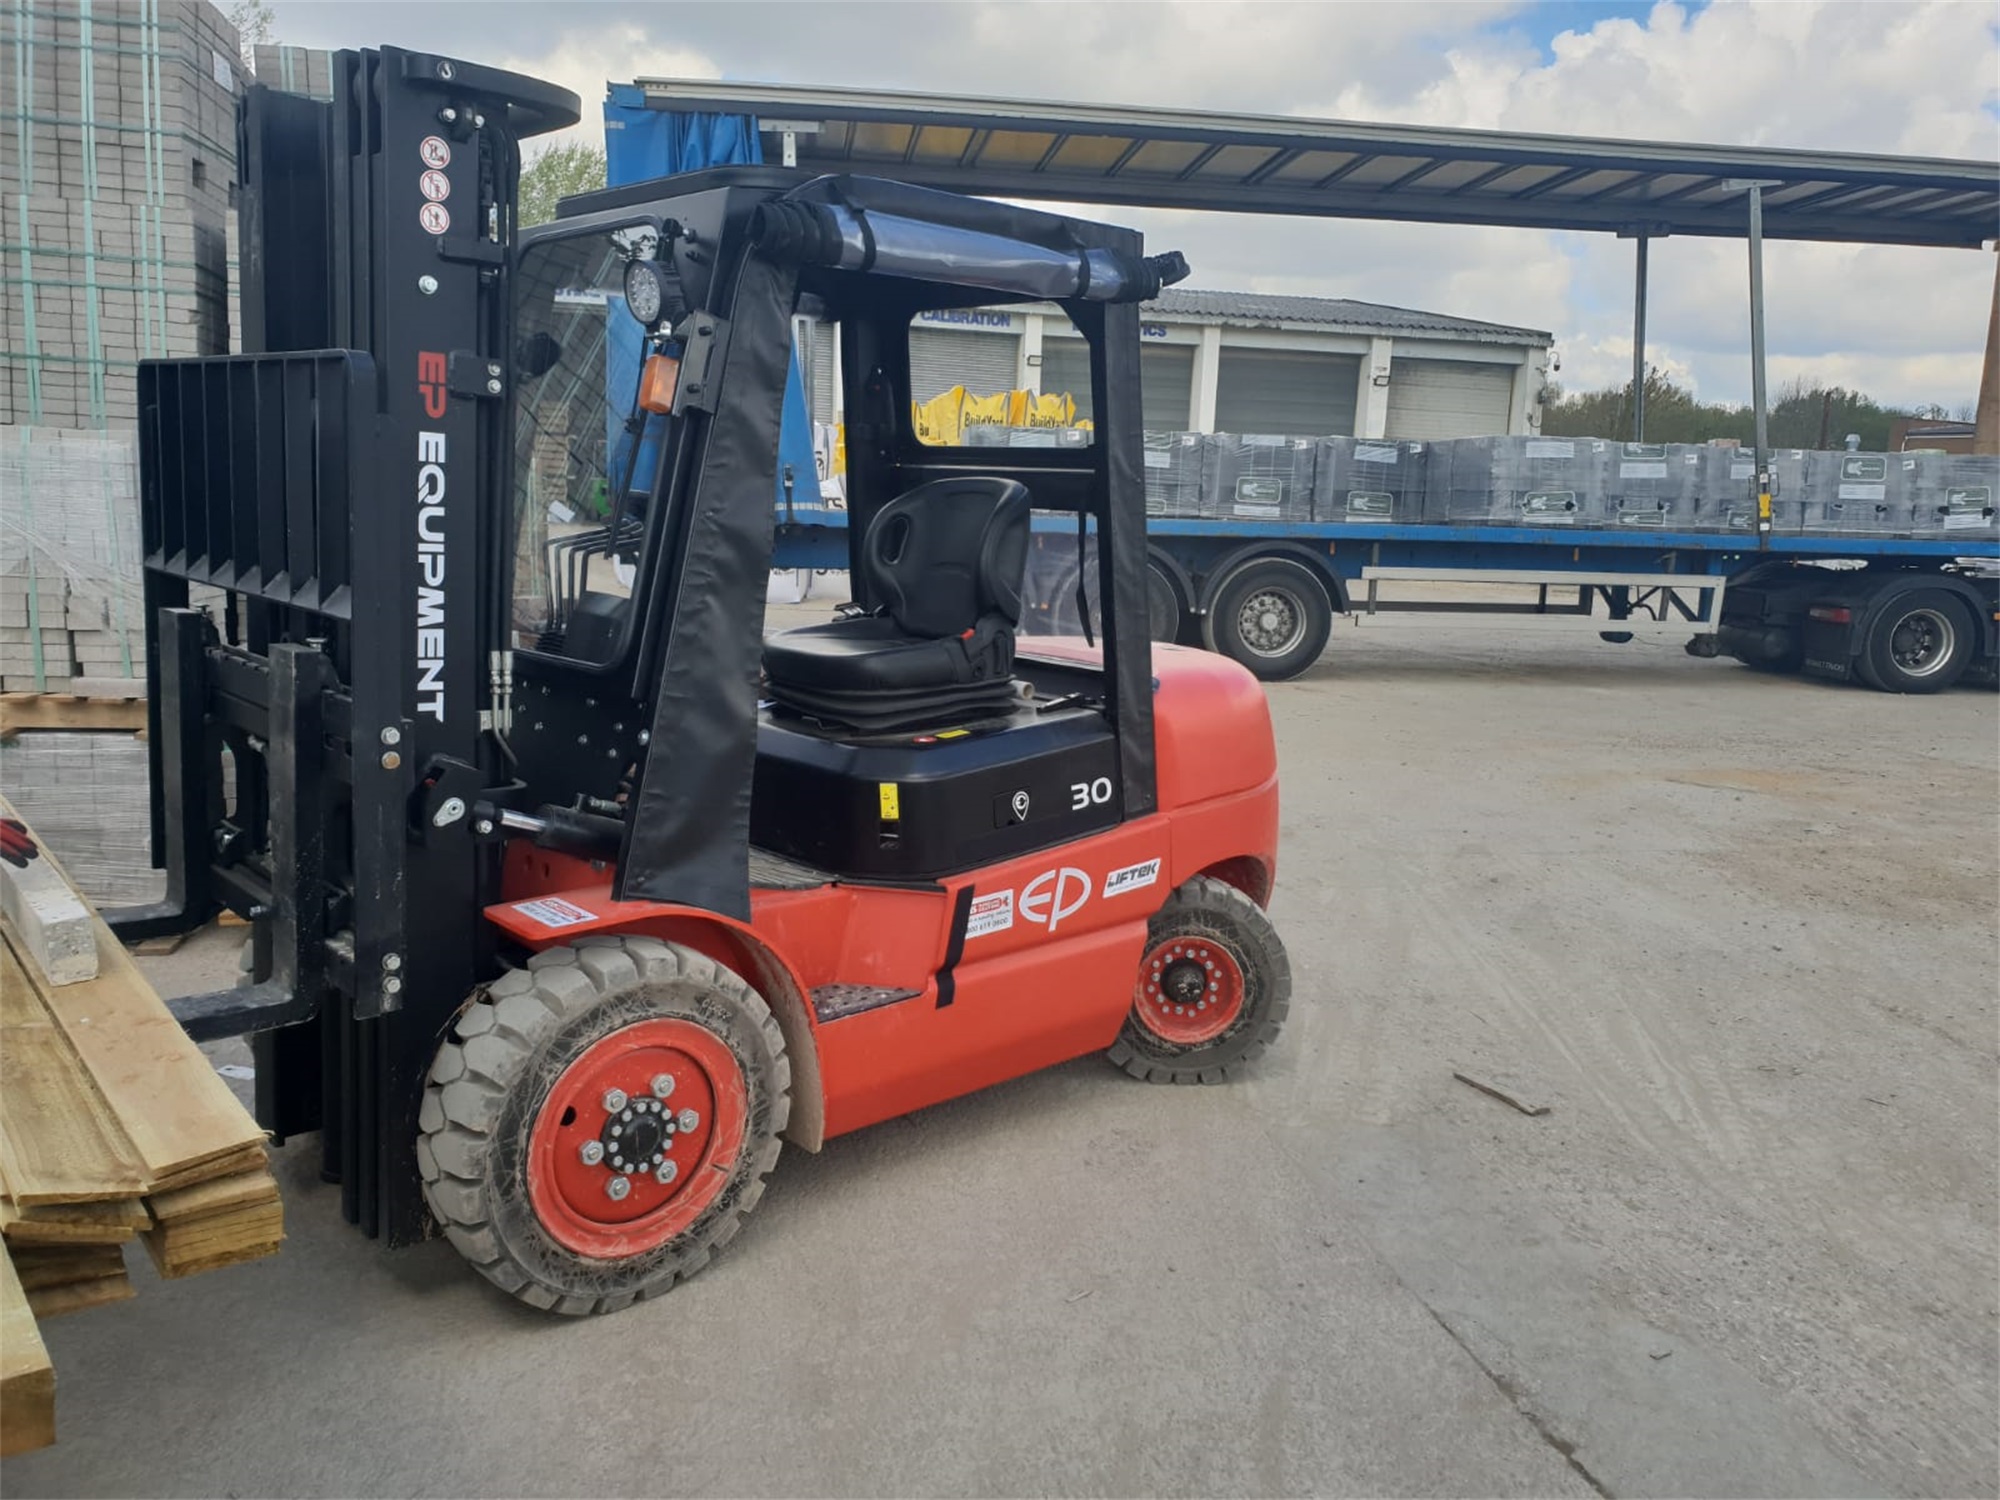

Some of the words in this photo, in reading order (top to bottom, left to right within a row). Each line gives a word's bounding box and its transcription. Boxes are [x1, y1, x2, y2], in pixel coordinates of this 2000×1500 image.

[921, 309, 1011, 327] CALIBRATION
[418, 351, 447, 418] EP
[417, 431, 446, 723] EQUIPMENT
[1071, 777, 1112, 810] 30
[1019, 867, 1092, 933] EP
